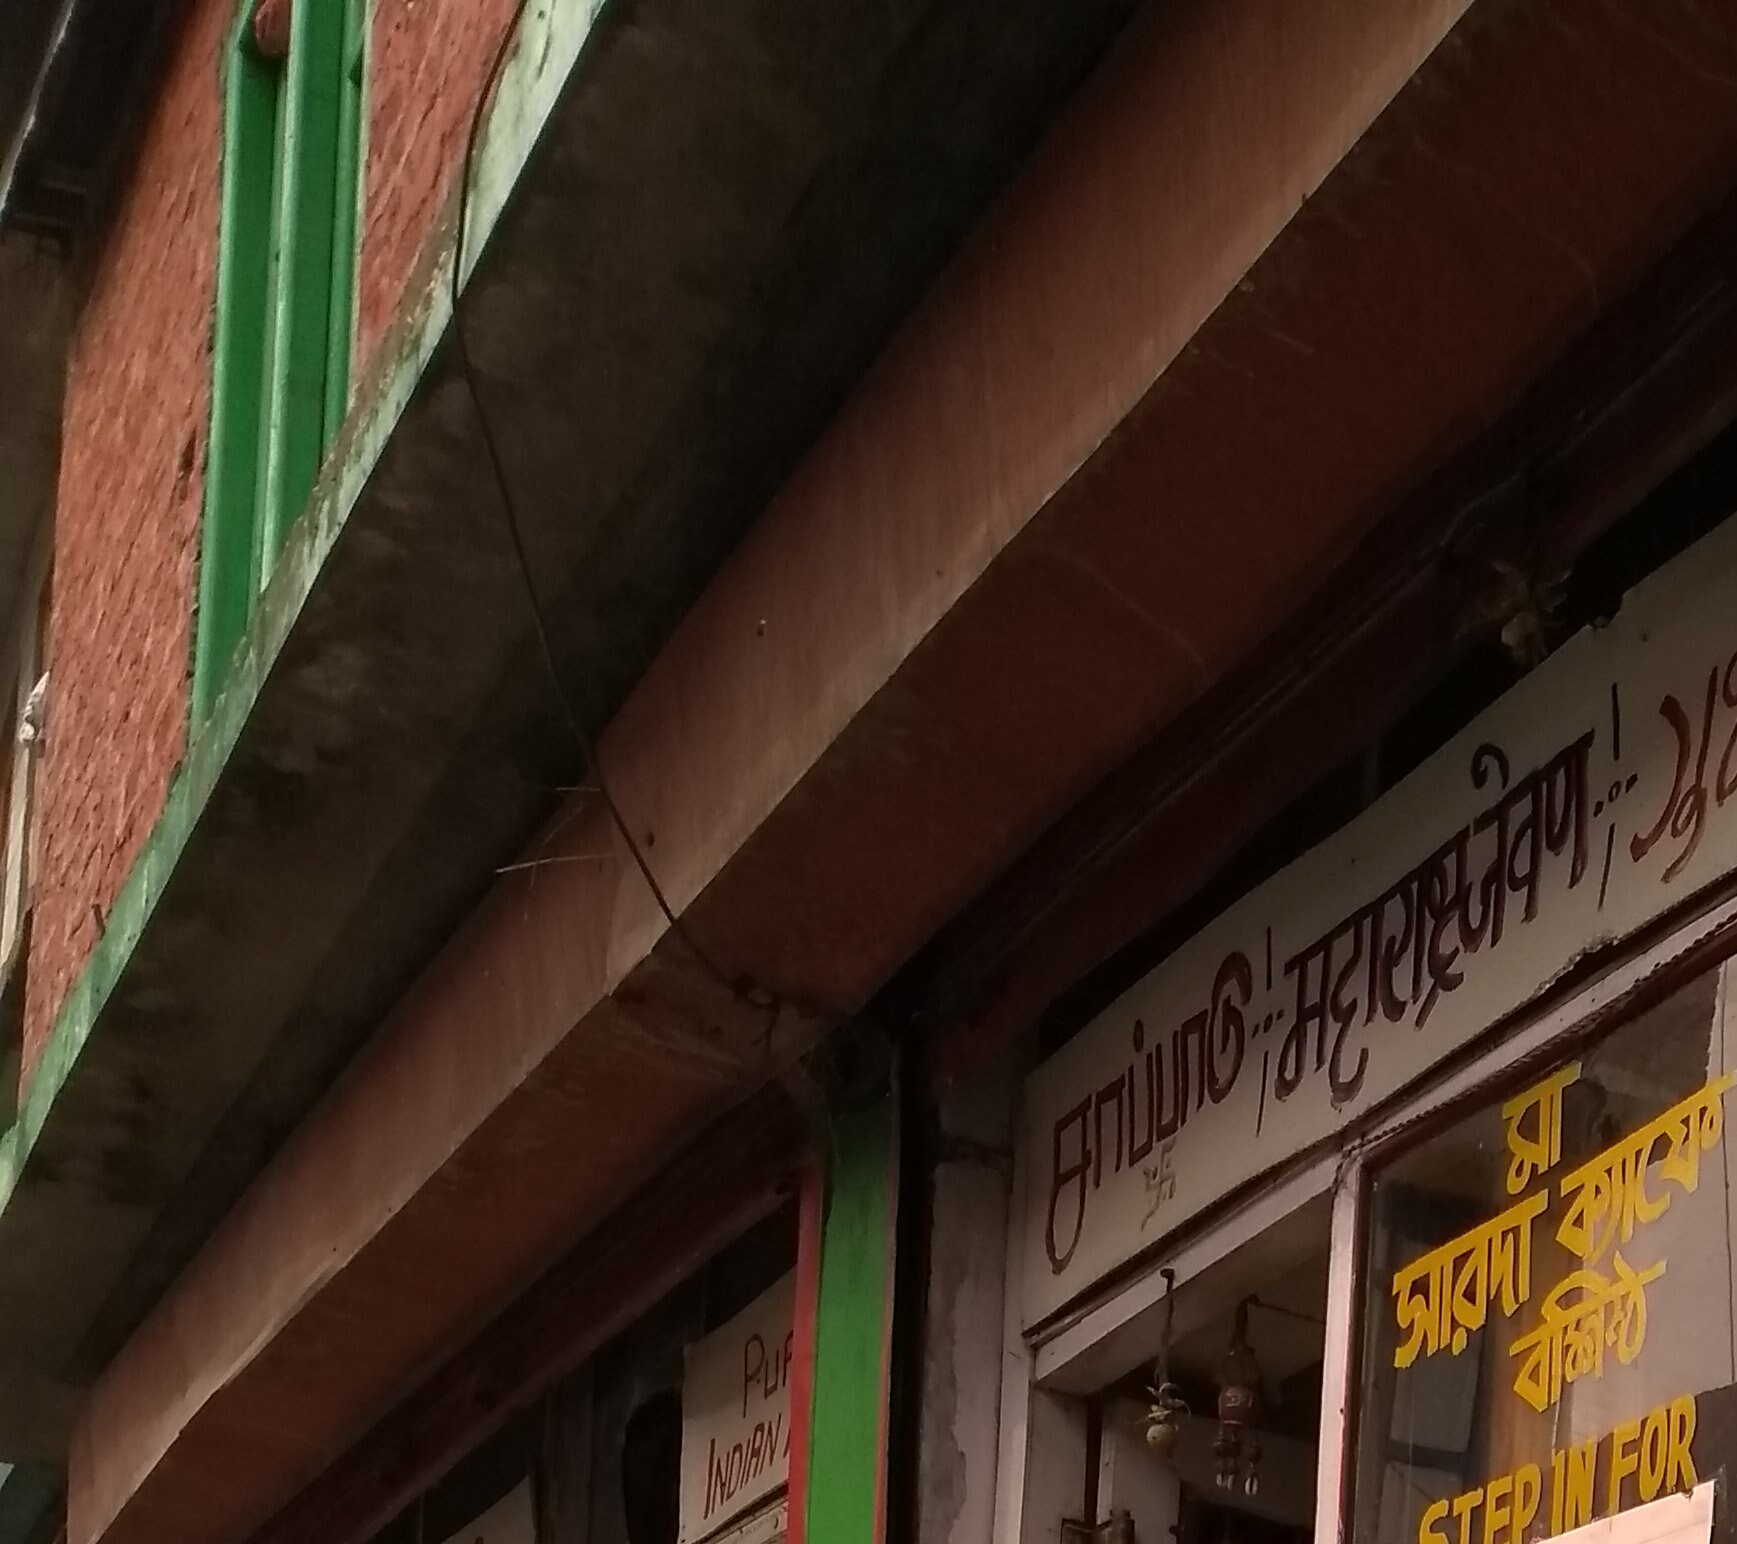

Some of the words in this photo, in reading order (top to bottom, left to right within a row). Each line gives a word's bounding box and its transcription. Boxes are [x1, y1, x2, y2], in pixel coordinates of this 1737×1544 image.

[1045, 951, 1252, 1276] சாப்பாடு
[1502, 1062, 1581, 1195] মা
[1392, 1188, 1549, 1368] সারদা
[703, 1413, 781, 1519] INDIAN
[1552, 1438, 1599, 1535] IN
[1609, 1394, 1698, 1513] FOR
